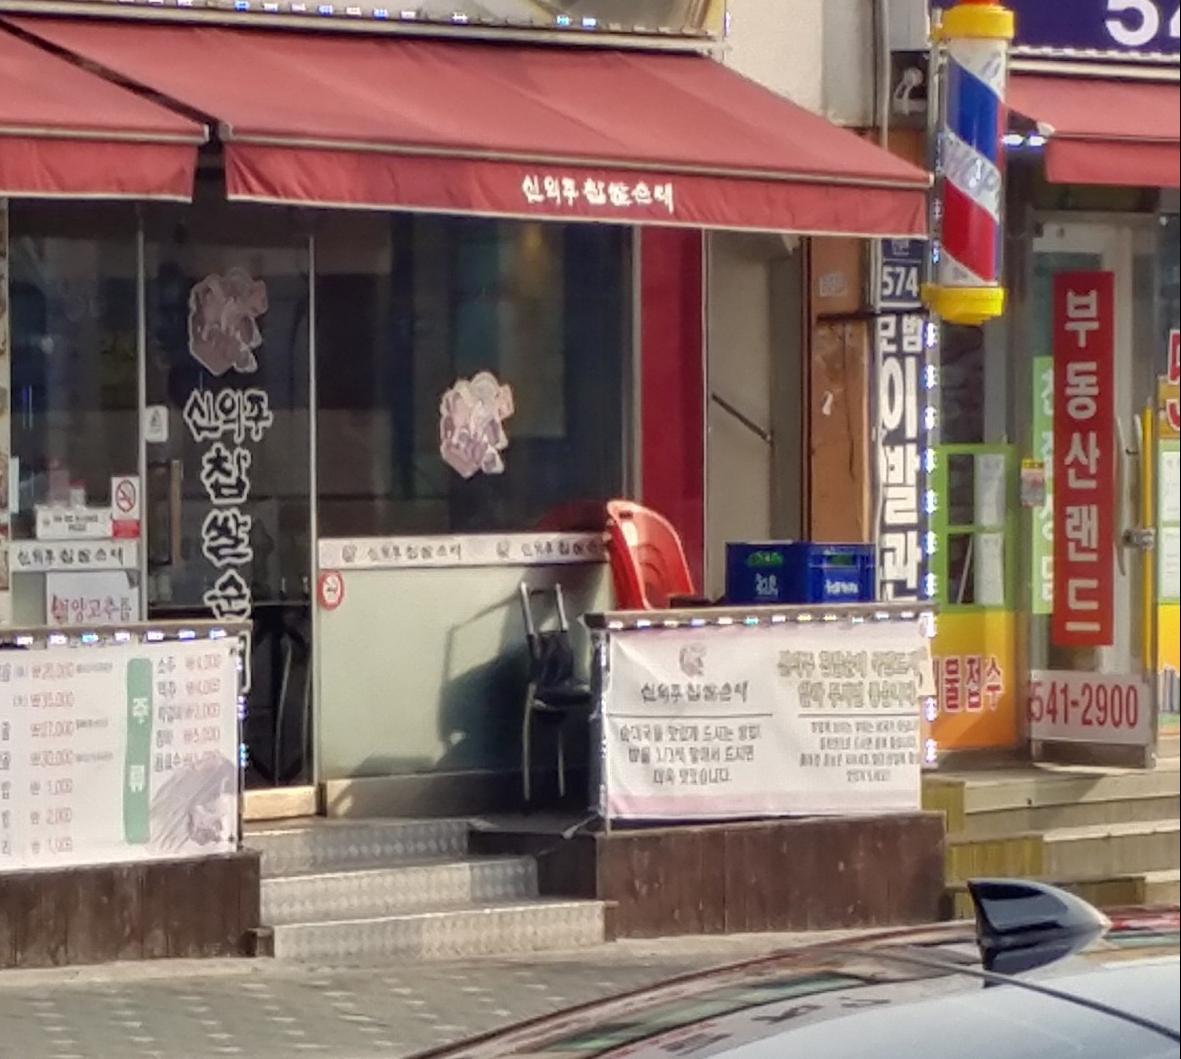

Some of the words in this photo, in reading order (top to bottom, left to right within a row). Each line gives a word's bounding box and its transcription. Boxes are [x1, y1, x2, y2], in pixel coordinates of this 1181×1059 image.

[882, 266, 919, 298] 574
[184, 391, 272, 441] 신의주
[1064, 290, 1100, 632] 부동산랜드
